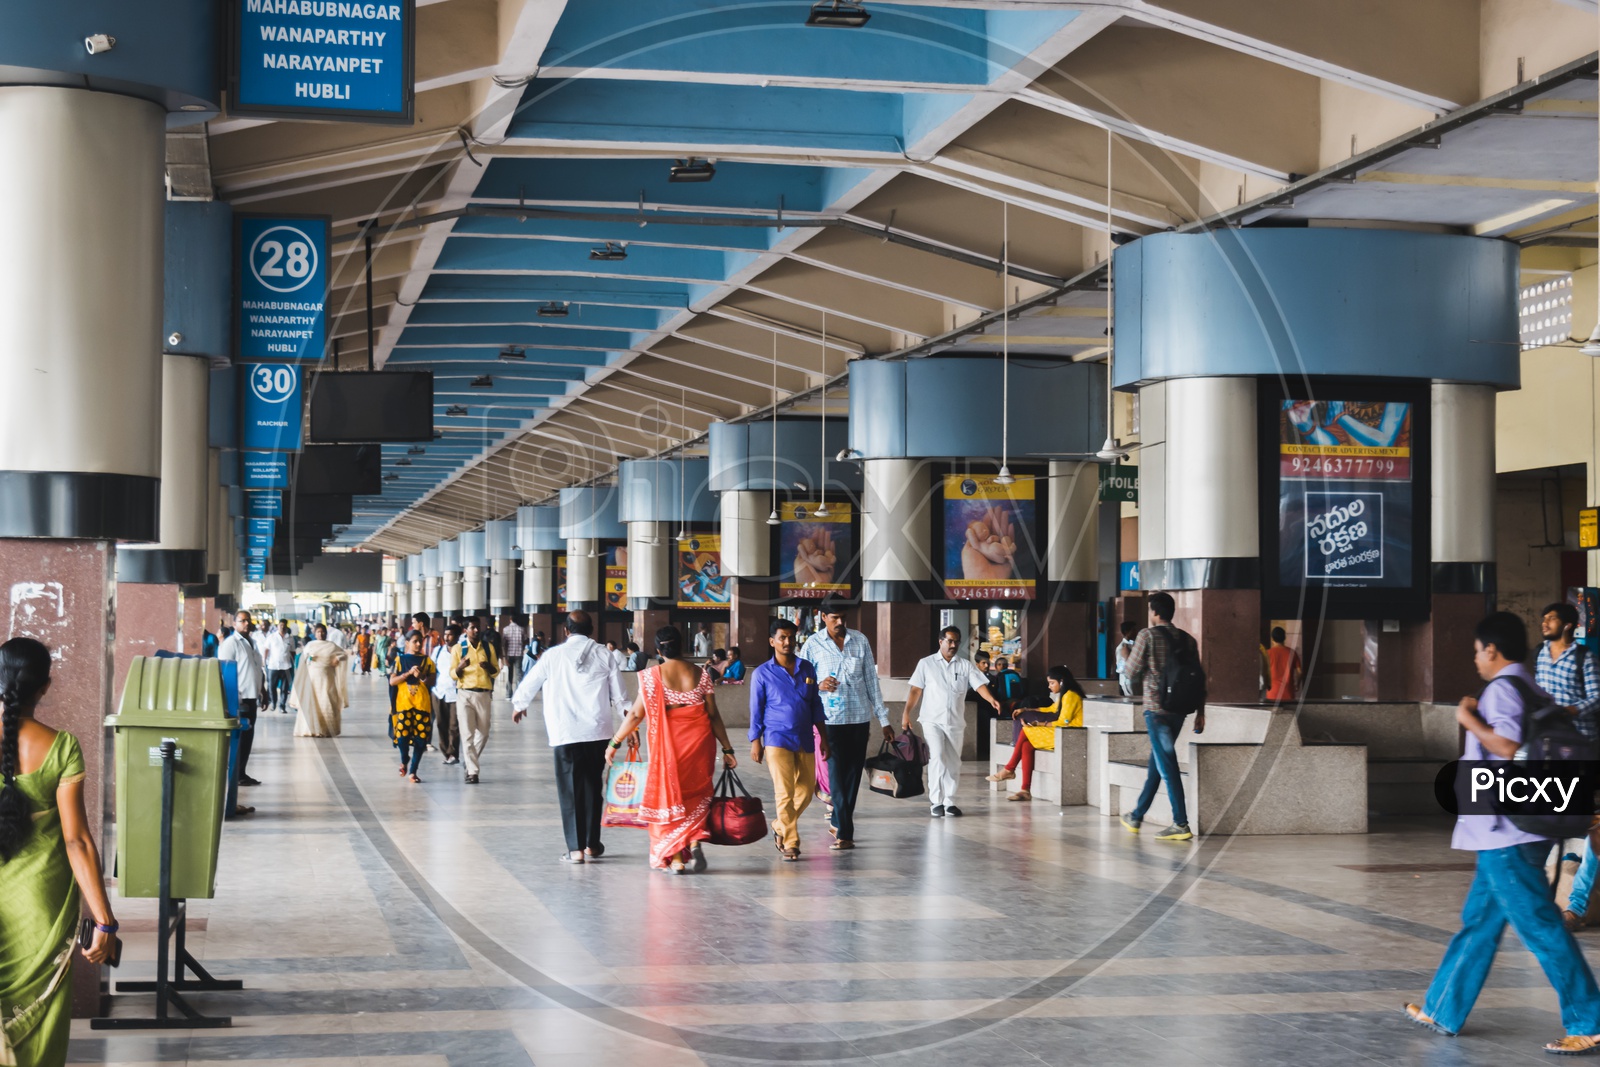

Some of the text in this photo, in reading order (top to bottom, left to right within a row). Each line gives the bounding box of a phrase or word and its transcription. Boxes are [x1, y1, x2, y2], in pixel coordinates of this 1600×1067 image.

[247, 0, 401, 21] MAHABUBNAGAR
[260, 26, 387, 47] WANAPARTHY
[263, 53, 384, 74] NARAYANPET
[295, 82, 350, 100] HUBLI
[260, 240, 310, 278] 28
[243, 300, 323, 311] MAHABUBNAGAR
[250, 315, 315, 325] WANAPARTHY
[251, 329, 314, 339] NARAYANPET
[267, 344, 297, 353] HUBLI
[257, 367, 291, 394] 30
[1287, 445, 1399, 455] CONTACT FOR ADVERTISEMENT
[1292, 457, 1395, 474] 9246377799
